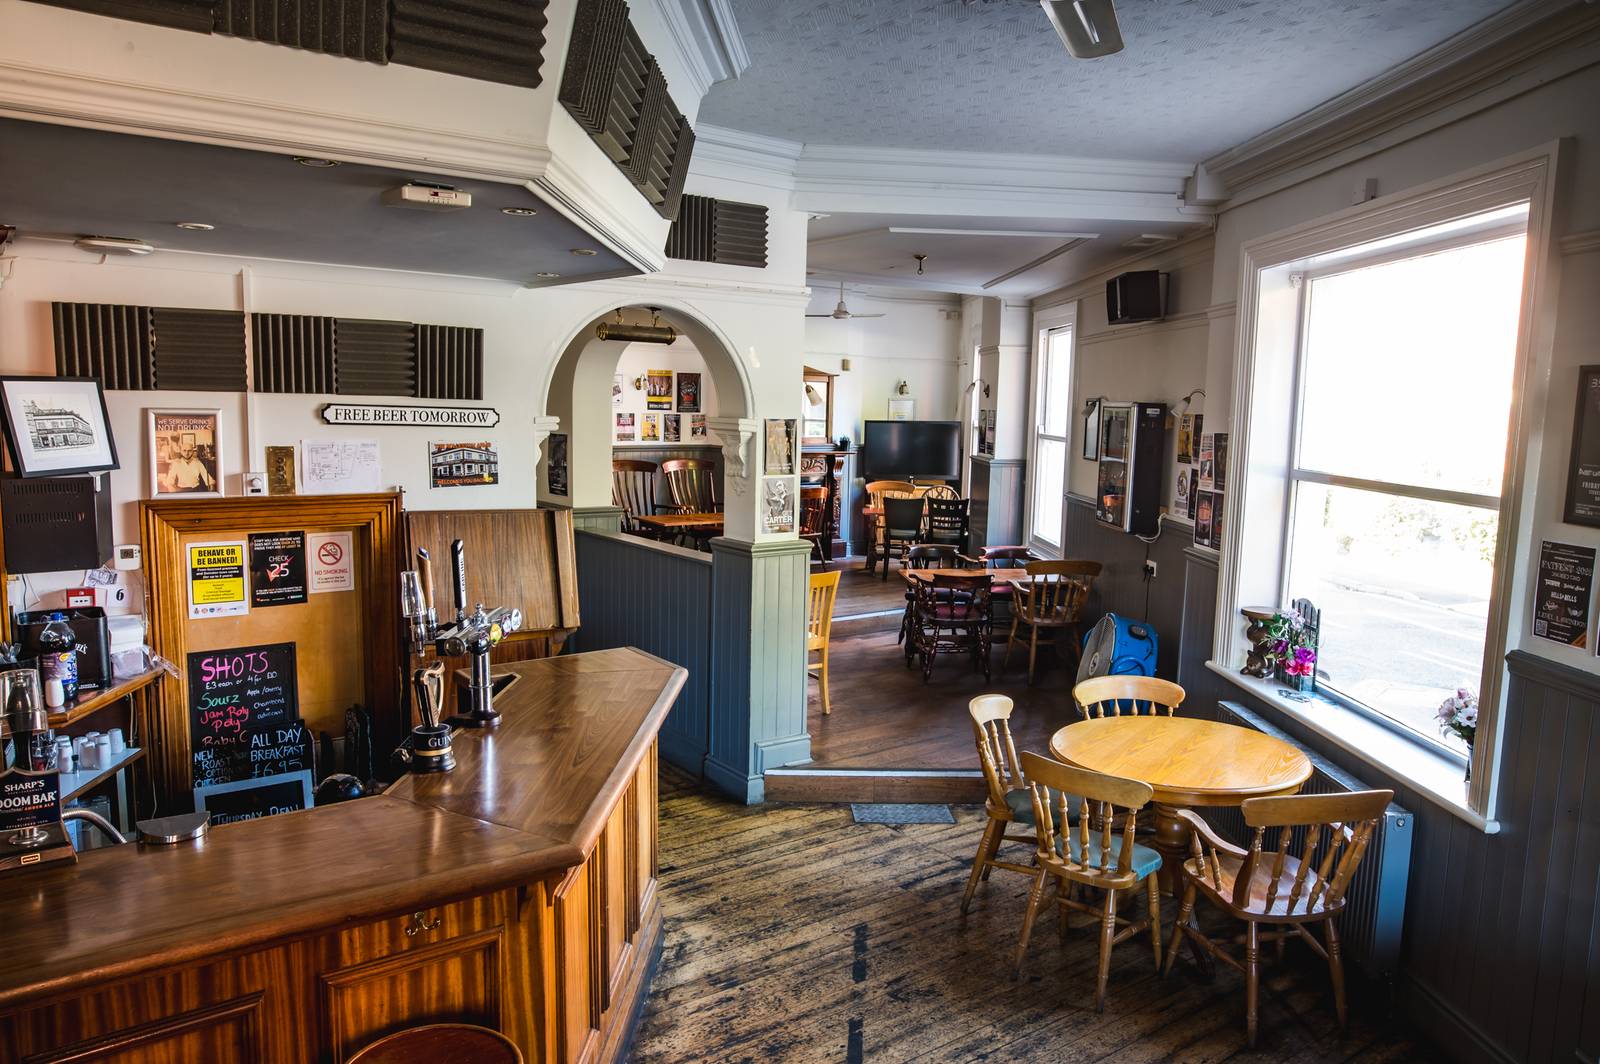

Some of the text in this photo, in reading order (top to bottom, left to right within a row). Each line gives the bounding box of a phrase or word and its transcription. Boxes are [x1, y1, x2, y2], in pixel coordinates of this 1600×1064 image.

[334, 408, 490, 424] FREE BEER TOMORROW
[198, 549, 224, 557] BEHAVE
[207, 556, 238, 565] BANNED!
[270, 563, 289, 577] 25
[116, 589, 124, 601] 6
[201, 652, 268, 682] SHOTS
[205, 682, 217, 690] £3
[197, 692, 240, 710] Sourz
[200, 706, 249, 724] Jam Roly
[252, 728, 302, 748] ALL DAY
[194, 749, 214, 762] NEW
[250, 744, 306, 762] BREAKFAST
[202, 757, 231, 770] ROAST
[251, 759, 303, 778] £6.95
[4, 780, 45, 792] SHARP'S
[32, 792, 56, 804] BAR
[212, 811, 263, 824] THURSDAY
